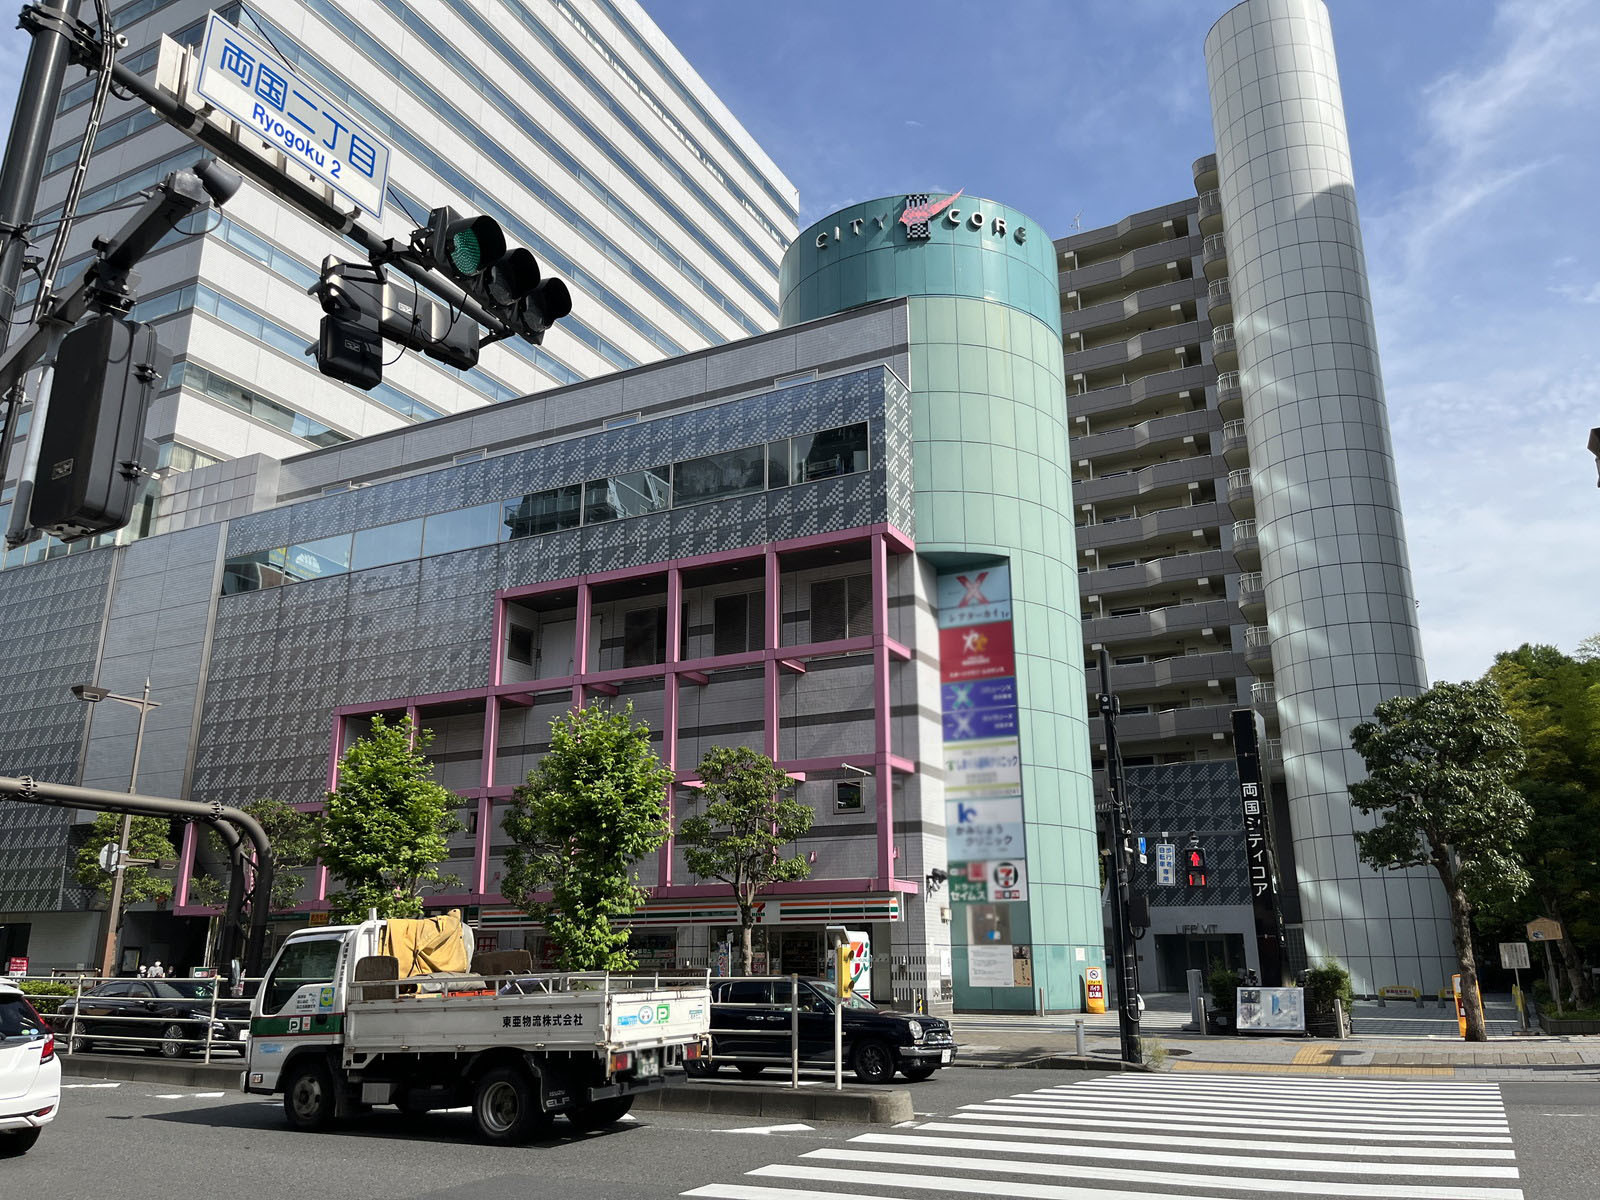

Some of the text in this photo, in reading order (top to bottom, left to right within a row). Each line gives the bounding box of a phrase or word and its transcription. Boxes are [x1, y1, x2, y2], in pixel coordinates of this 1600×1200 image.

[220, 38, 376, 178] 両国二丁目
[253, 102, 342, 179] Ryogoku 2
[815, 208, 1027, 249] CITY CORE
[1242, 782, 1268, 897] 両国シティコア
[950, 890, 986, 901] セイムス
[502, 1013, 583, 1028] 東亜物流株式会社
[545, 1096, 570, 1108] ELF
